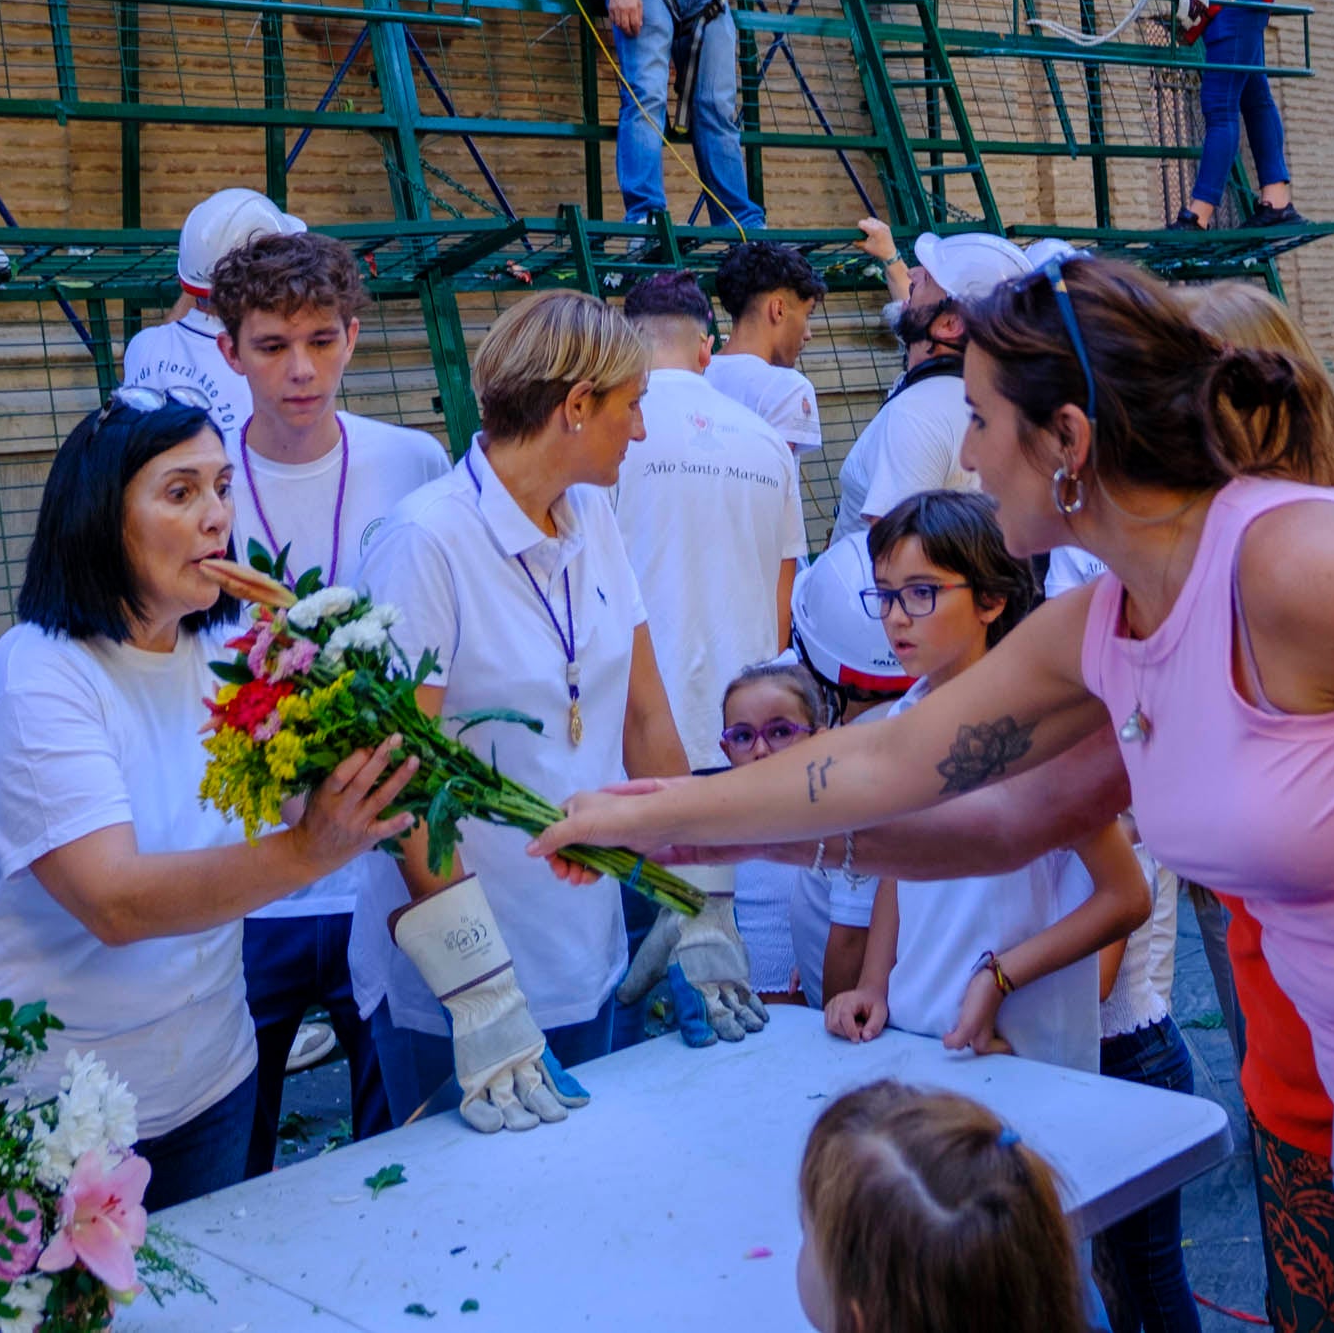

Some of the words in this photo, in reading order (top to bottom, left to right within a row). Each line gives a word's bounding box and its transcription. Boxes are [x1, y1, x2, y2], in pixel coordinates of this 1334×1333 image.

[157, 360, 197, 379] Floral
[198, 373, 219, 399] Año
[643, 459, 676, 477] Año
[681, 460, 720, 476] Santo
[724, 466, 779, 489] Mariano
